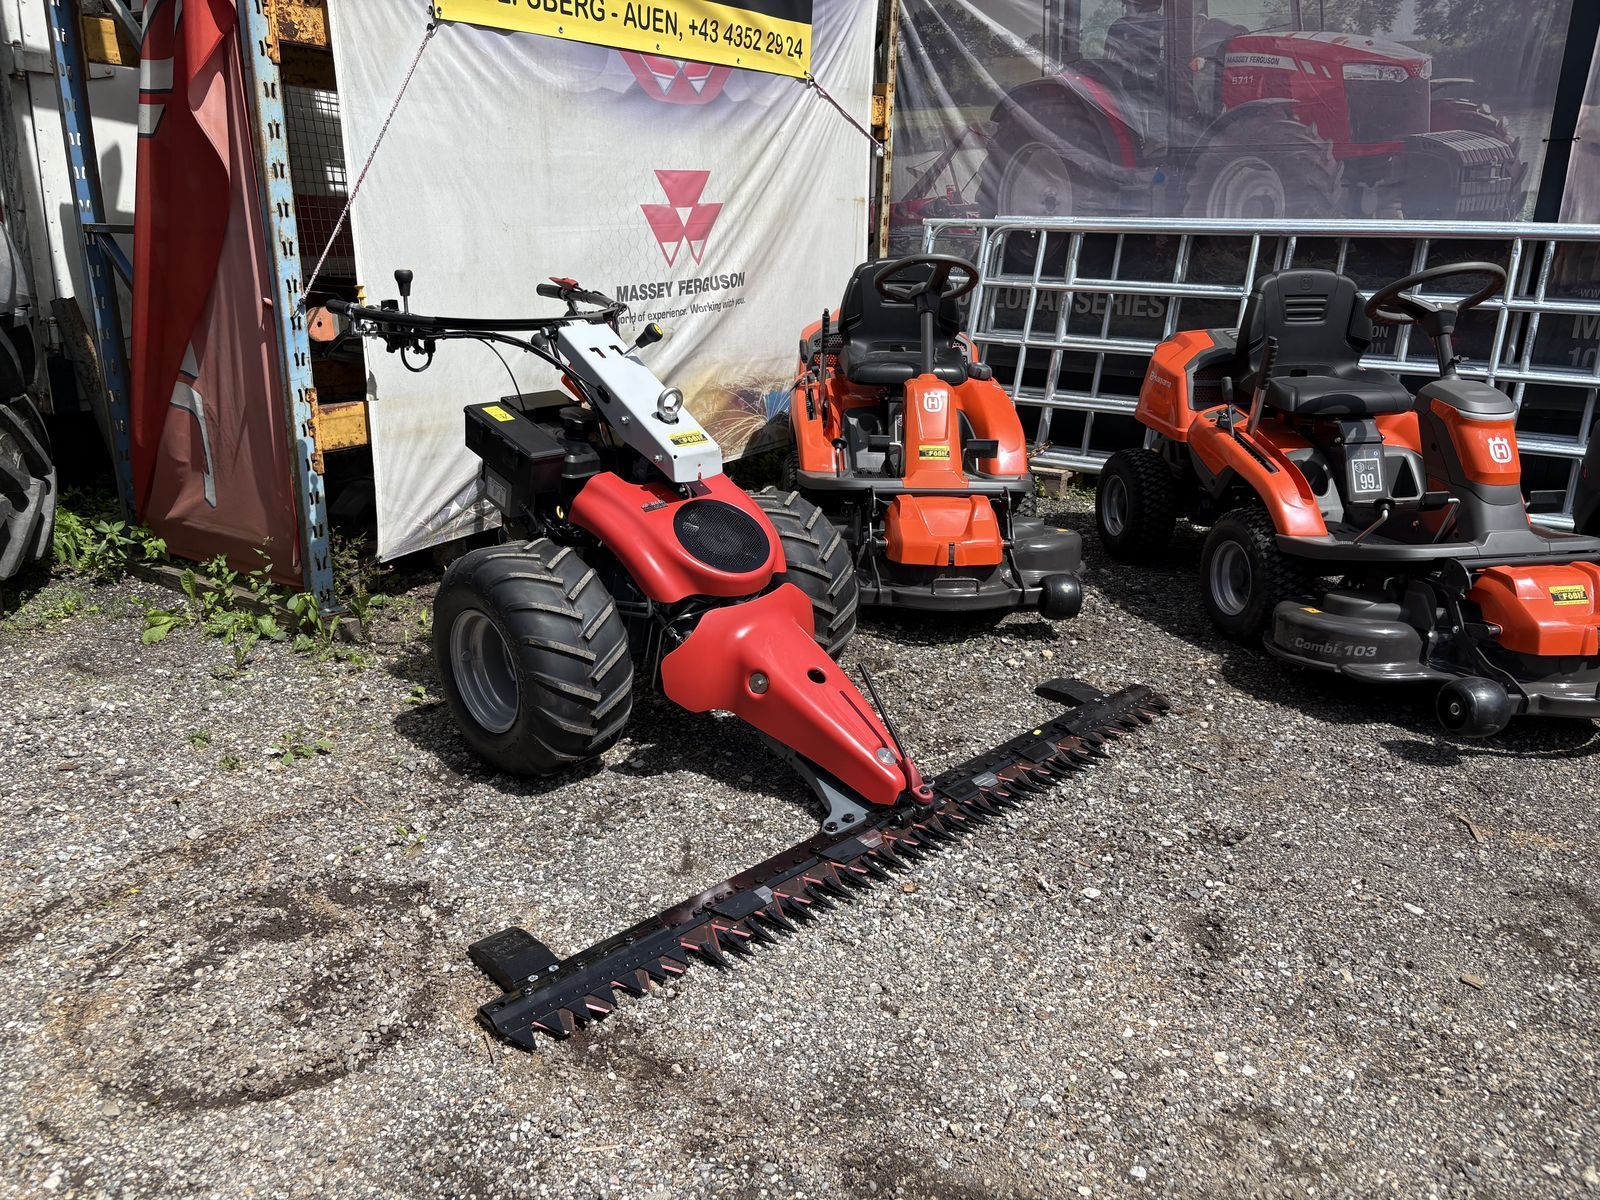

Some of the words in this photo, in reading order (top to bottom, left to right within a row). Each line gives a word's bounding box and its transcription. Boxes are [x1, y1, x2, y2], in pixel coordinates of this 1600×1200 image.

[623, 2, 682, 41] AUEN,
[688, 18, 719, 43] +43
[723, 23, 762, 51] 4352
[765, 31, 784, 54] 29
[786, 35, 803, 59] 24
[1249, 56, 1280, 65] FERGUSON
[616, 281, 673, 302] MASSEY
[678, 271, 745, 296] FERGUSON
[638, 311, 646, 322] of
[690, 300, 722, 314] Working
[722, 298, 735, 309] with
[1360, 473, 1376, 489] 99
[1294, 637, 1338, 655] Combi
[1344, 645, 1378, 657] 103
